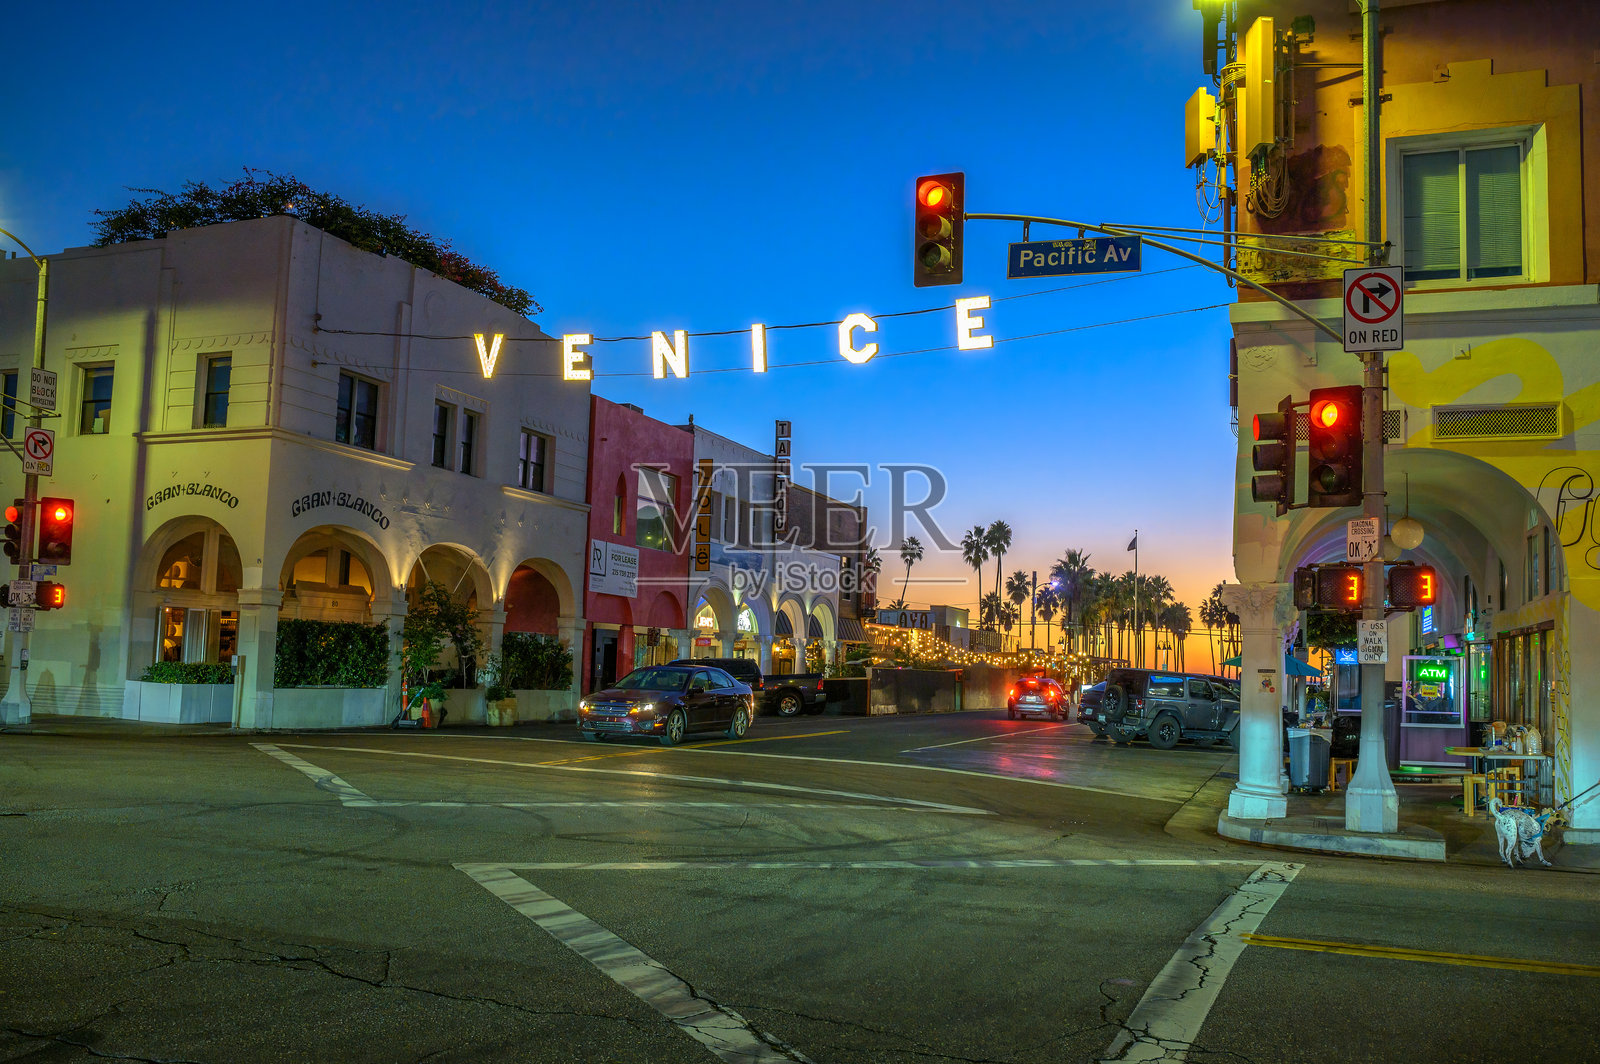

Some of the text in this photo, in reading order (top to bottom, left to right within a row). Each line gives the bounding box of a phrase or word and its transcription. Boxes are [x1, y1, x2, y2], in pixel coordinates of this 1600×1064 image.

[1019, 246, 1096, 268] Pacific
[1103, 244, 1132, 263] Av
[473, 295, 994, 381] VENICE
[1349, 329, 1398, 344] ON RED
[32, 372, 56, 386] DO NOT
[31, 385, 55, 398] BLOCK
[1351, 520, 1375, 528] DIAGONAL
[1351, 527, 1375, 535] CROSSING
[1349, 541, 1361, 558] OK
[611, 553, 622, 562] FOR
[621, 555, 637, 566] LEASE
[1348, 575, 1358, 600] 3
[1421, 575, 1432, 599] 3
[55, 588, 62, 603] 3
[1363, 637, 1382, 645] WALK
[1419, 668, 1446, 678] ATM
